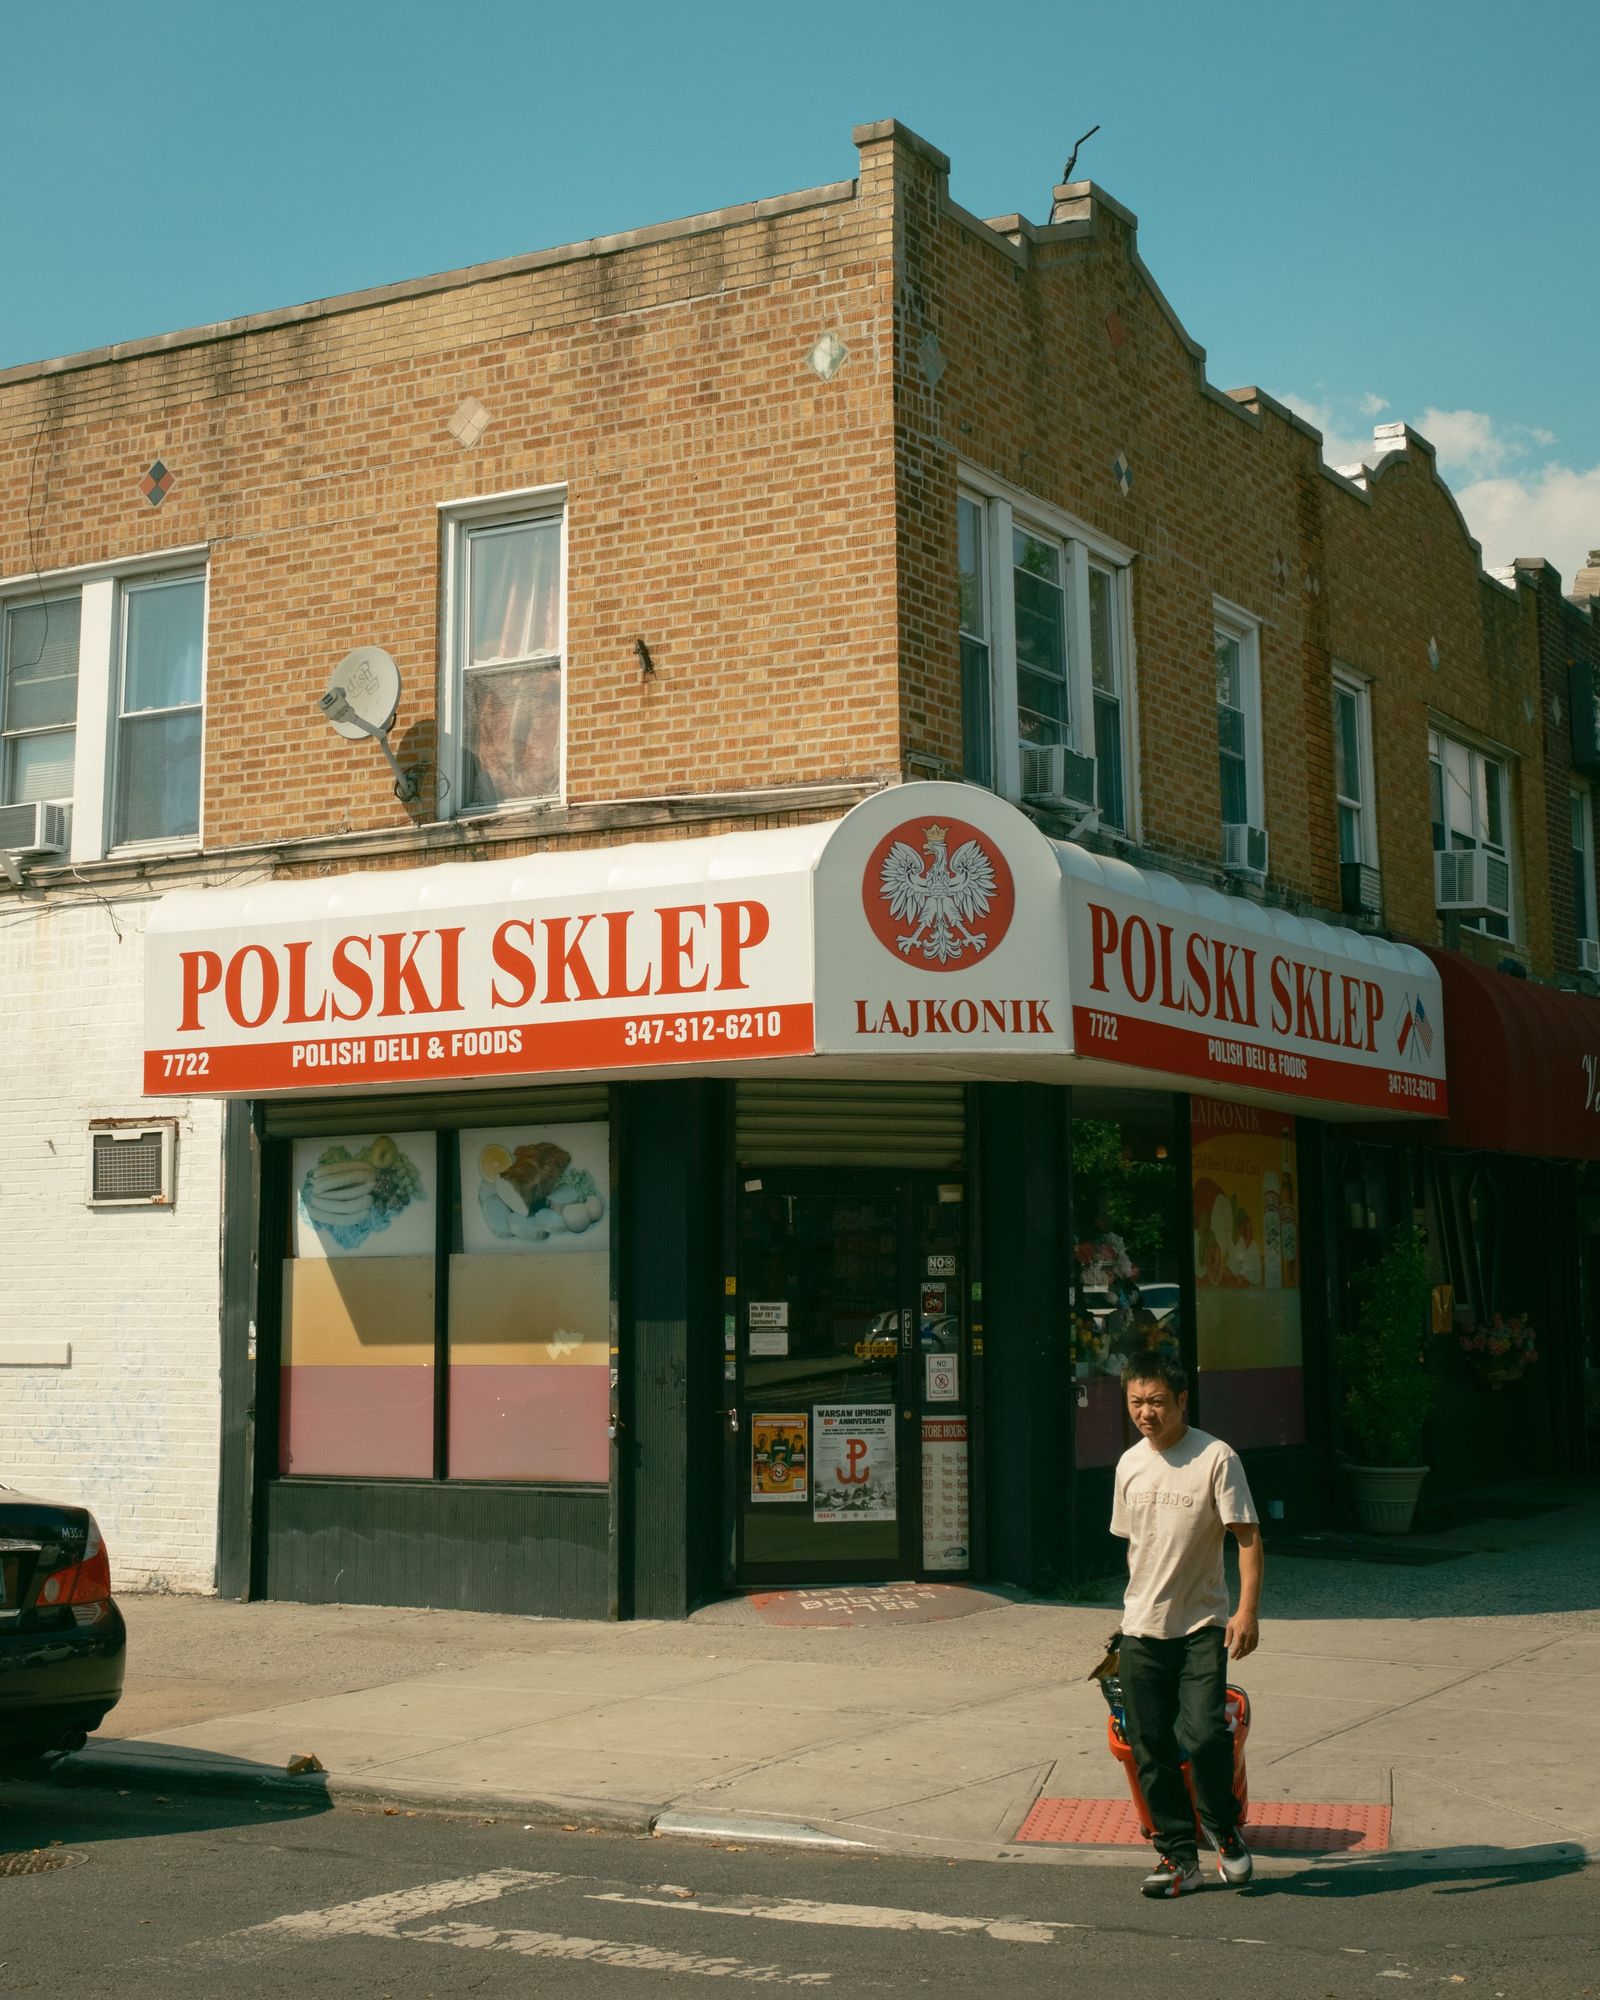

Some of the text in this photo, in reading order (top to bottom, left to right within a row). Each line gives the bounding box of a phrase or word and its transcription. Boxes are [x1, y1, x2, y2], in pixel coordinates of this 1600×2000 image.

[177, 900, 770, 1032] POLSKI SKLEP
[1087, 902, 1385, 1053] POLSKI SKLEP
[625, 1011, 781, 1047] 347-312-6210
[854, 999, 1055, 1038] LAJKONIK
[1089, 1012, 1119, 1041] 7722
[292, 1029, 523, 1068] POLISH DELI & FOODS
[1208, 1039, 1308, 1080] POLISH DELI & FOODS
[162, 1052, 210, 1077] 7722
[1388, 1074, 1437, 1101] 347-312-6210
[1190, 1098, 1261, 1131] LAJKONIK
[929, 1257, 945, 1268] NO
[922, 1284, 932, 1293] NO
[817, 1409, 892, 1418] WARSAW UPRISING
[921, 1424, 967, 1438] STORE HOURS
[799, 1592, 936, 1610] BAGELS
